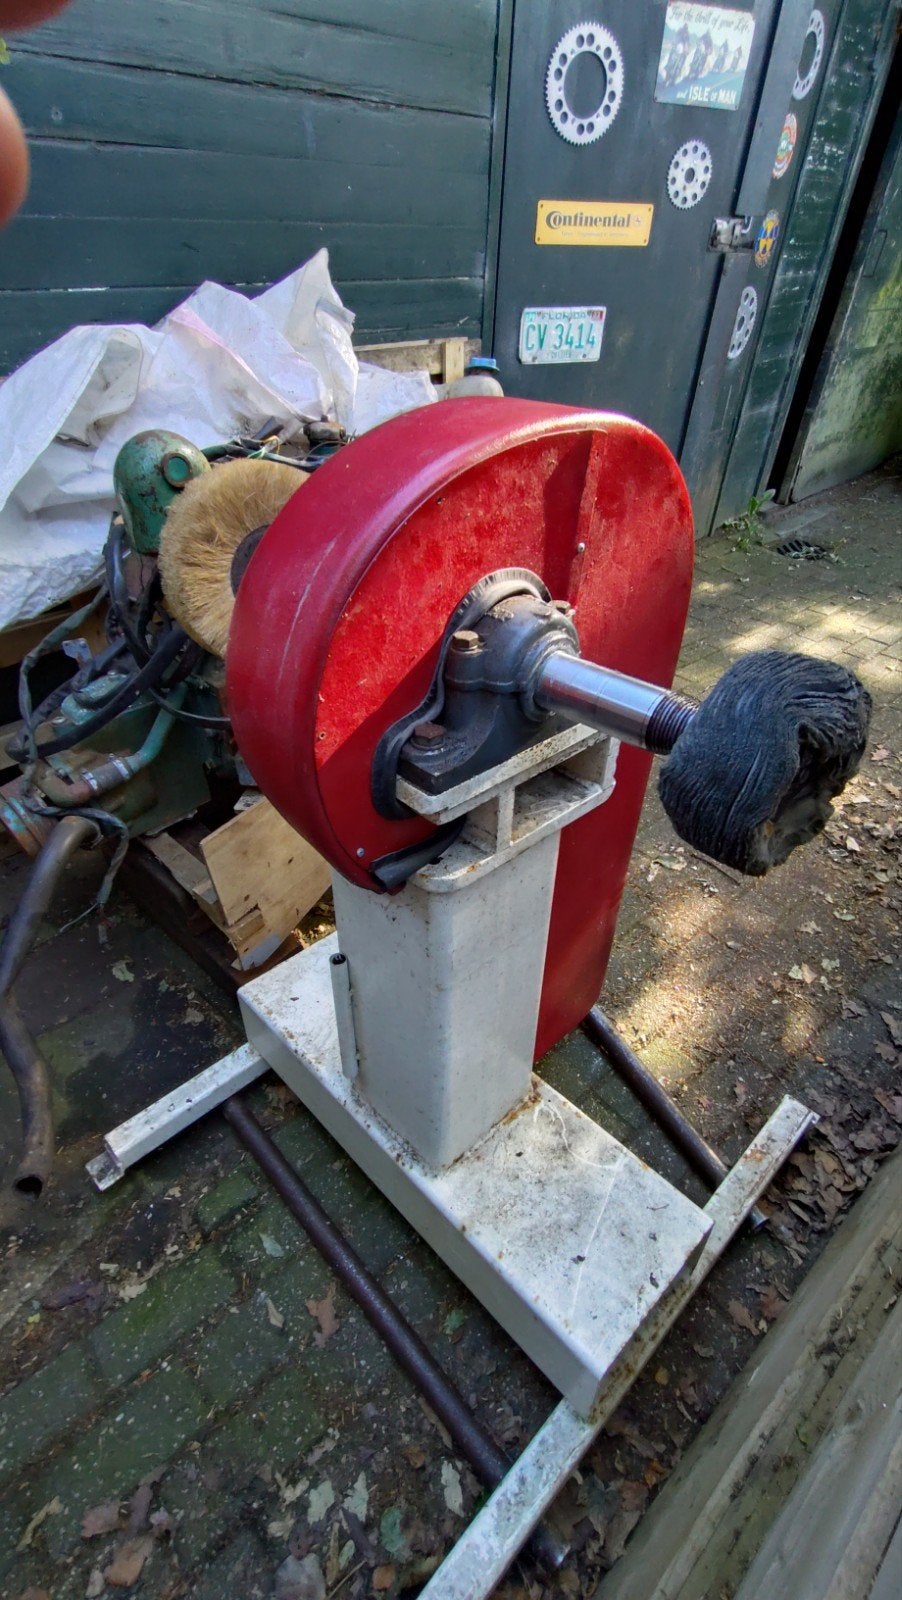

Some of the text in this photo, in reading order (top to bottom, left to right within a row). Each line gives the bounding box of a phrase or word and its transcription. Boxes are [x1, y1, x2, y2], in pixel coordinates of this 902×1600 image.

[688, 86, 711, 102] ISLE
[718, 89, 737, 104] MAN
[545, 210, 631, 230] Continental
[542, 311, 586, 320] FLORIDA
[525, 323, 596, 351] CV 3414
